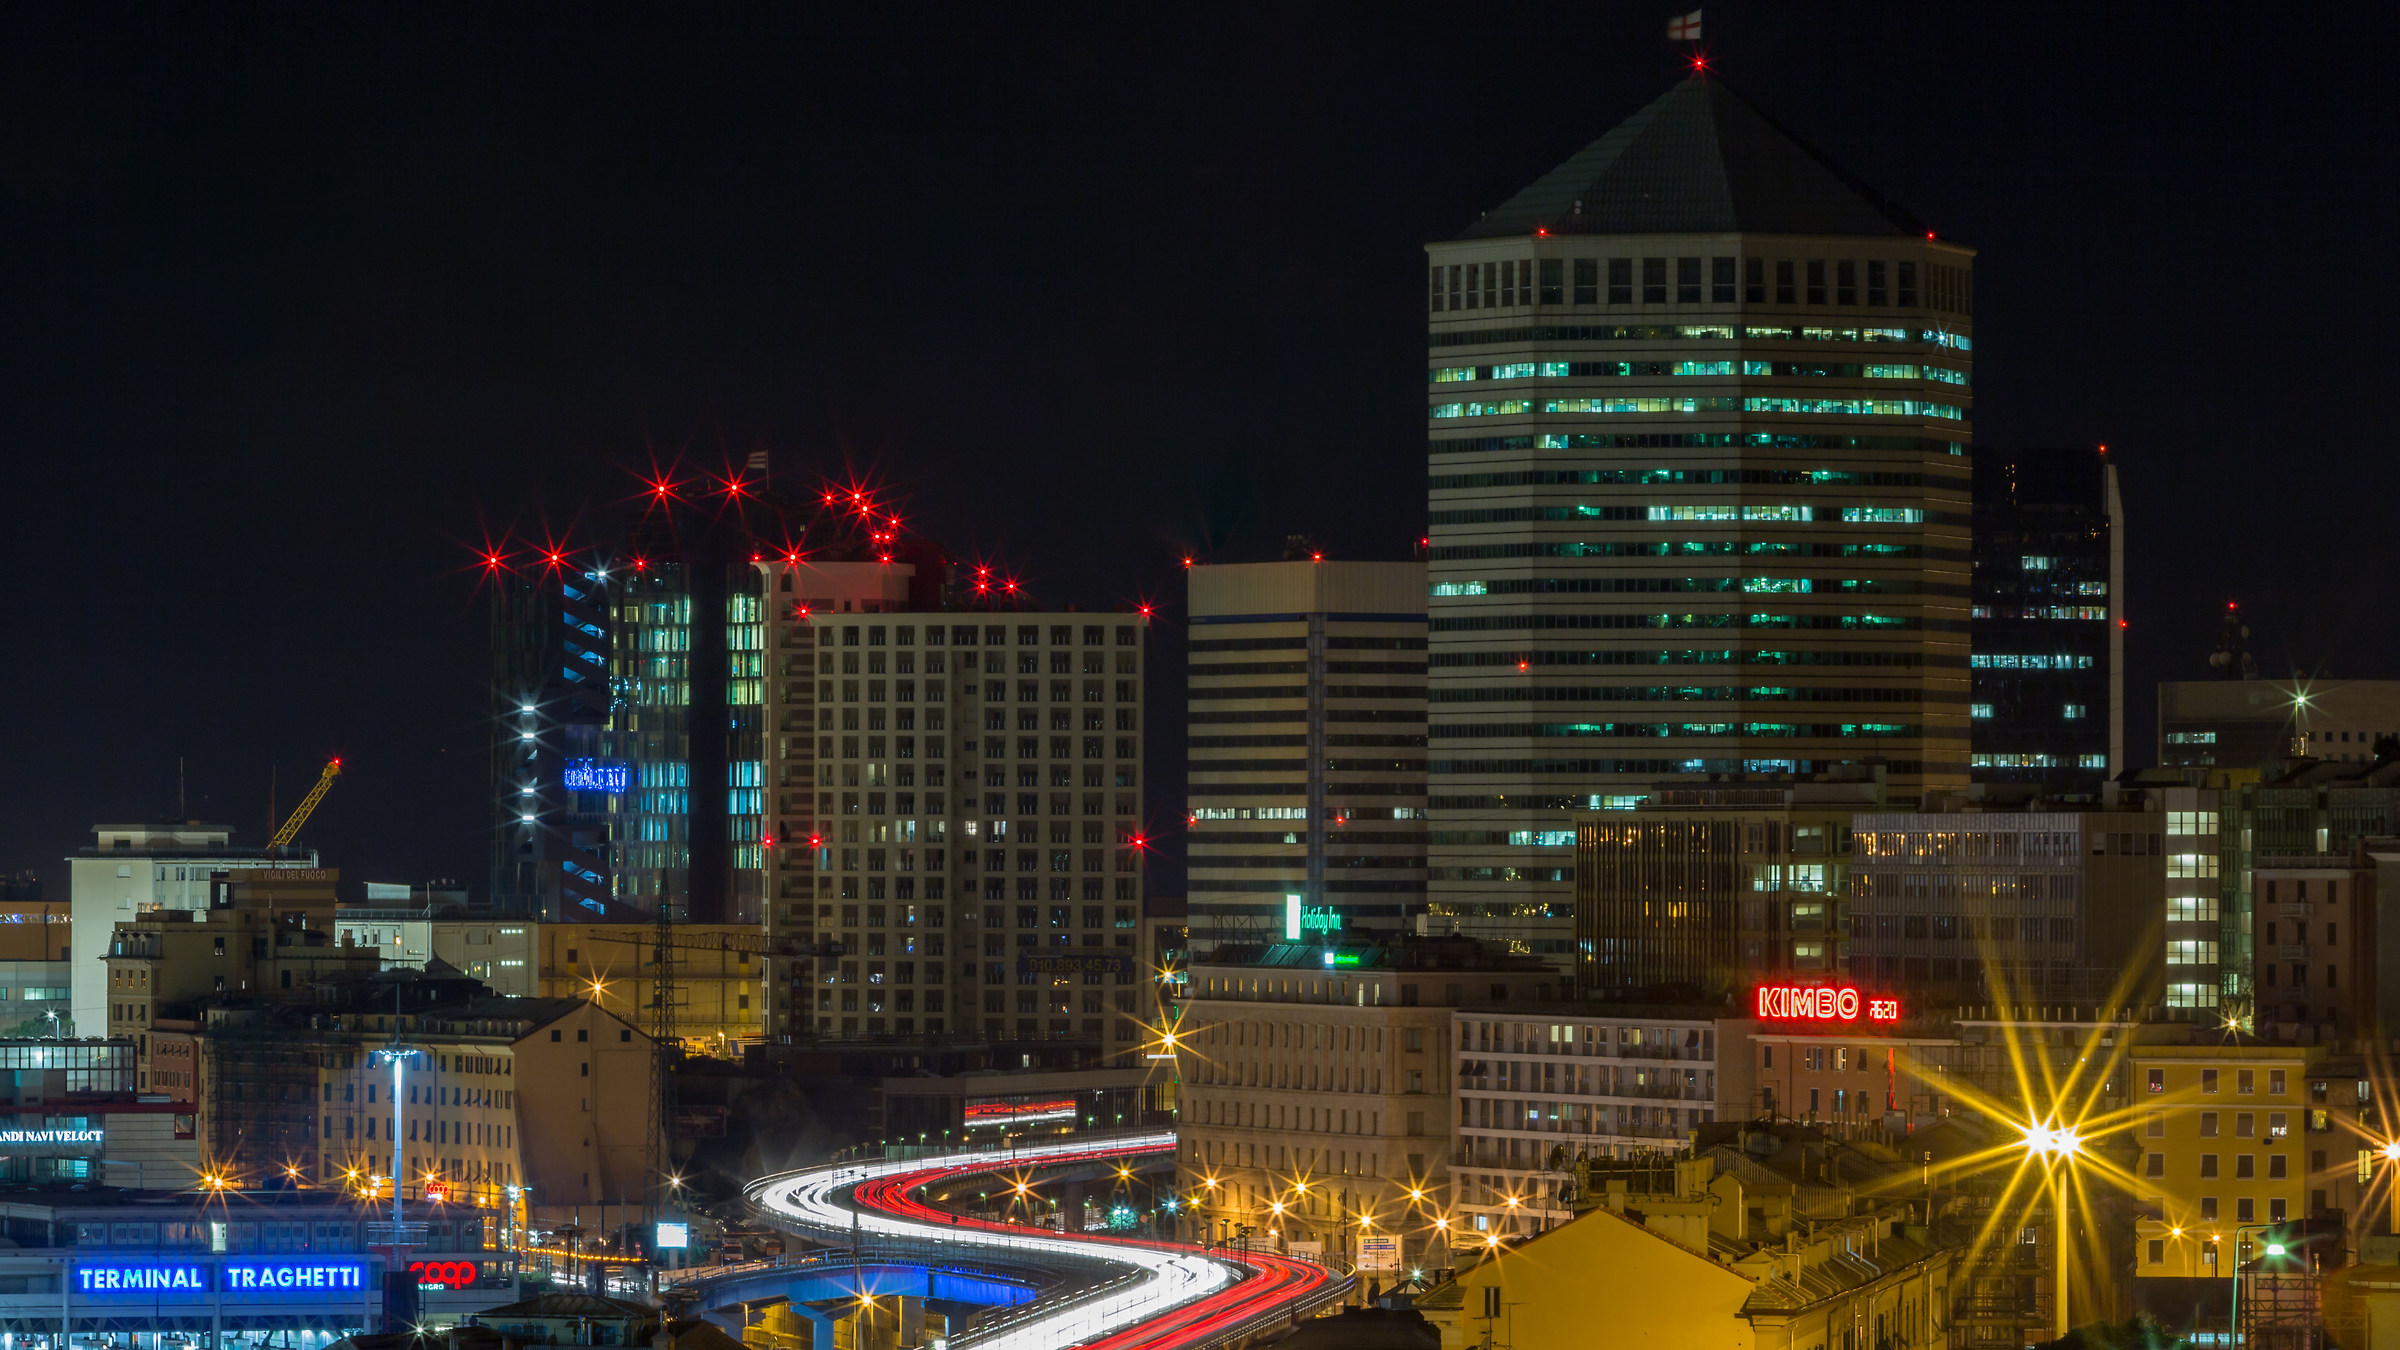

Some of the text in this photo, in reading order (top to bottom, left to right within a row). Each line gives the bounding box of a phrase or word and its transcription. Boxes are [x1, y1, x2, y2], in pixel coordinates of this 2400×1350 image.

[263, 871, 326, 880] VIGILI DEL FUOCO
[1302, 906, 1342, 935] Holiday Inn
[1029, 959, 1121, 972] 010.893.45.73
[1759, 987, 1858, 1020] KIMBO
[26, 1131, 54, 1141] NAVI
[80, 1267, 360, 1289] TERMINAL TRAGHETTI
